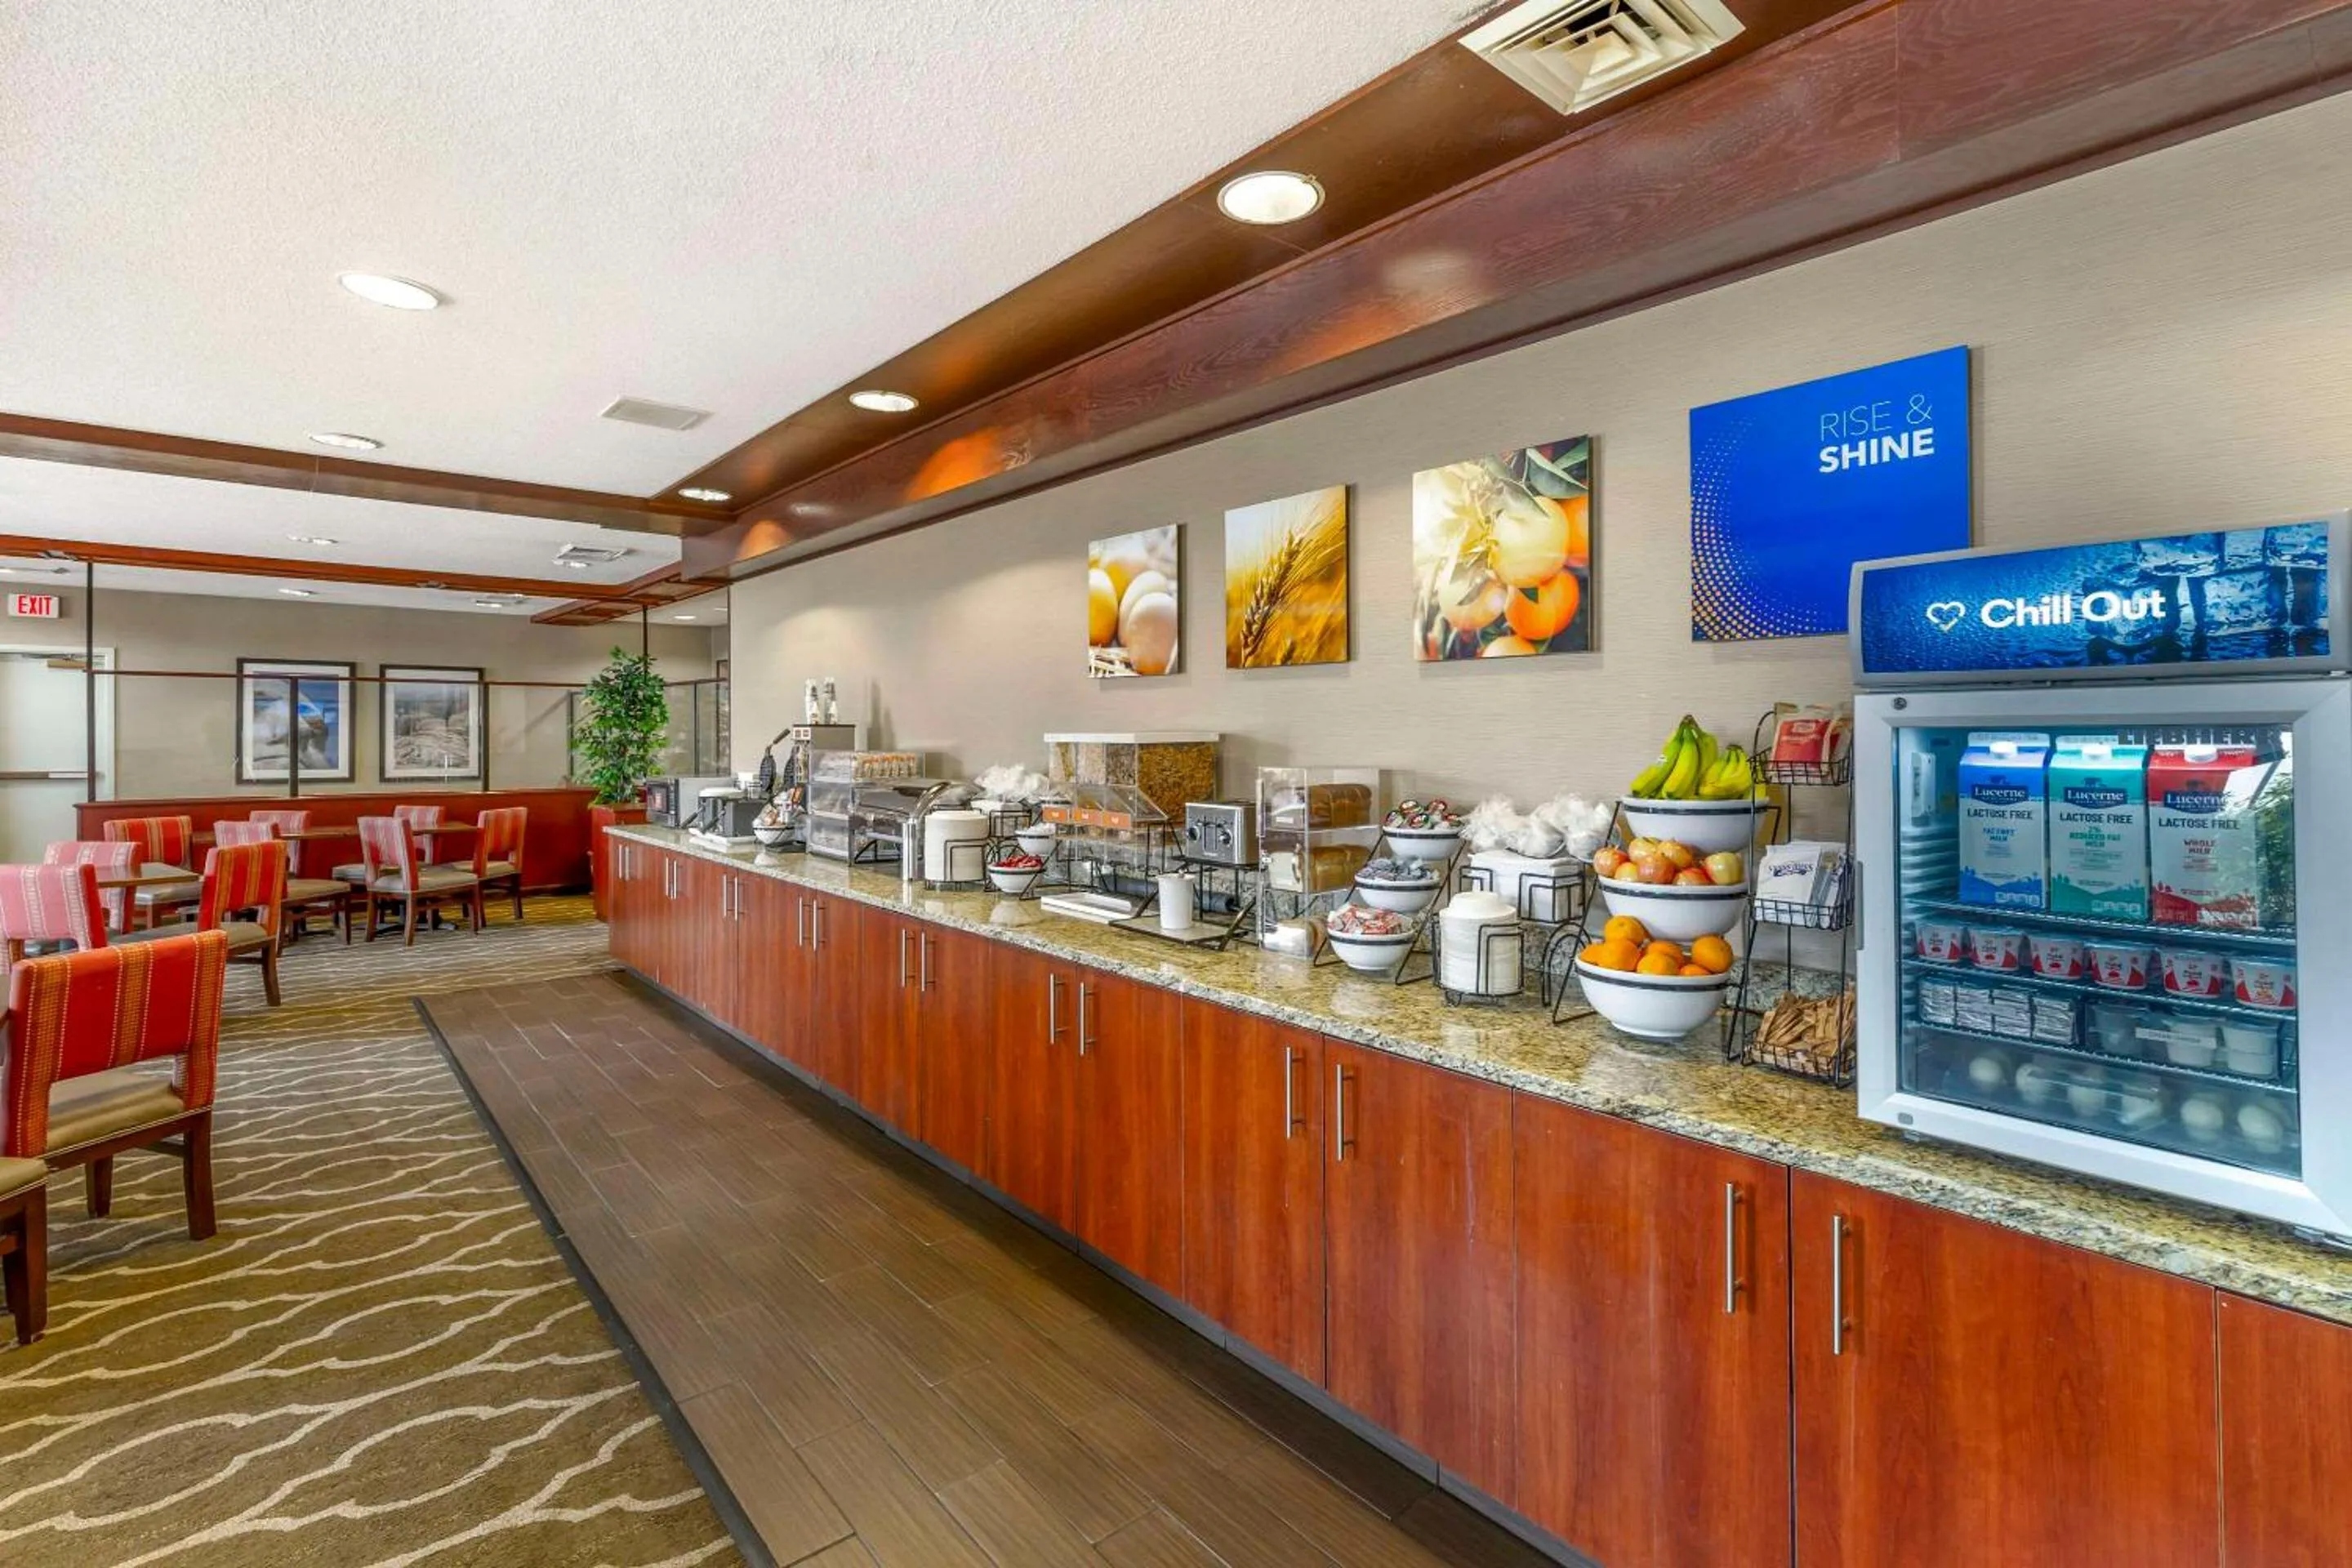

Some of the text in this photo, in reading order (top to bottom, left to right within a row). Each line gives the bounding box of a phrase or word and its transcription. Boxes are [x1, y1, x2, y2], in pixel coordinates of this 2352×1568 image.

[1820, 394, 1932, 442] RISE &
[1819, 428, 1935, 473] SHINE
[18, 595, 51, 615] EXIT
[1980, 590, 2167, 628] Chill Out
[1975, 786, 2025, 798] Lucerne
[2067, 790, 2124, 800] Lucerne
[1967, 808, 2033, 820] LACTOSE FREE
[2060, 811, 2133, 824] LACTOSE FREE
[2158, 817, 2240, 830] LACTOSE FREE
